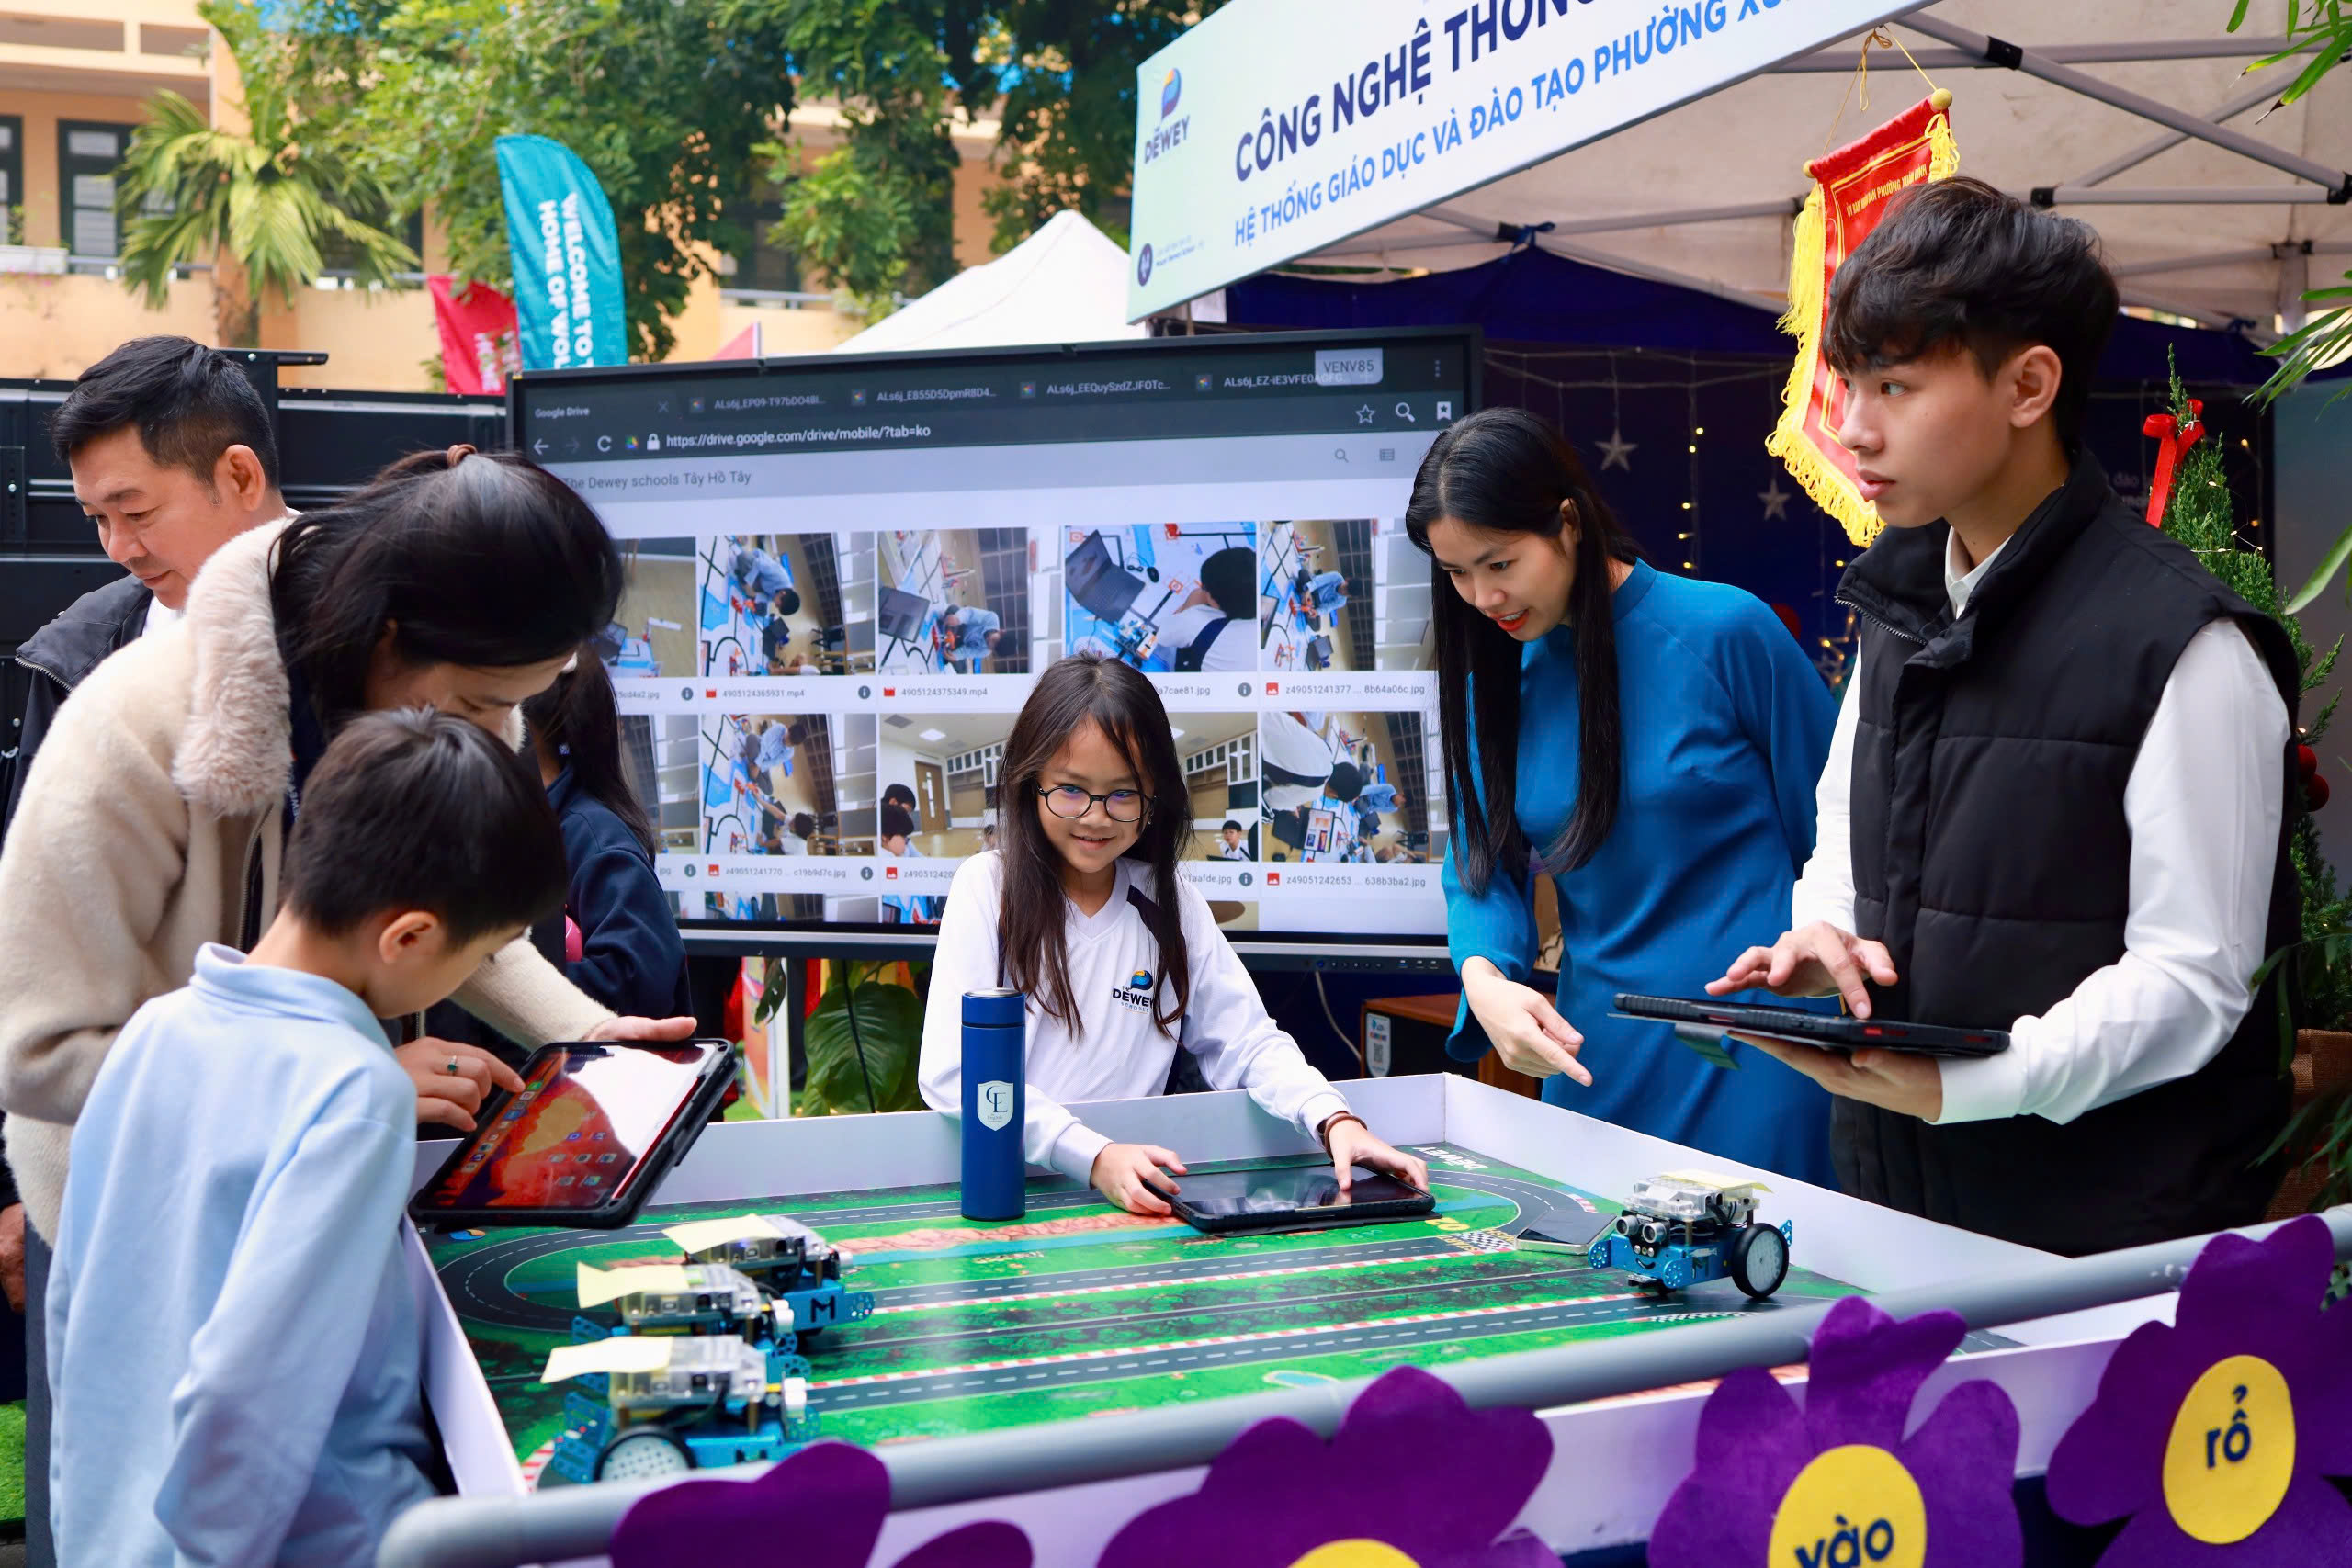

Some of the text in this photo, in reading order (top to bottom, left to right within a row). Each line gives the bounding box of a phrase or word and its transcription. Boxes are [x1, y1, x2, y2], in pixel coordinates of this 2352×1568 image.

[1236, 95, 1321, 182] CÔNG
[1333, 18, 1431, 134] NGHỆ
[1235, 206, 1256, 247] HỆ
[1261, 180, 1322, 233] THỐNG
[1328, 154, 1375, 202] GIÁO
[1382, 132, 1425, 180] DỤC
[1432, 107, 1463, 154] VÀ
[1470, 87, 1523, 140] ĐÀO
[1532, 58, 1585, 111] TẠO
[1594, 0, 1726, 84] PHƯỜNG
[538, 199, 564, 276] HOME
[560, 192, 591, 320] WELCOME
[548, 276, 568, 310] OF
[574, 320, 594, 357] TO
[1323, 359, 1374, 373] VENV85
[535, 406, 590, 419] Google Drive
[666, 424, 931, 448] https://drive.google.com/drive/mobile/?tab=ko
[589, 476, 628, 491] Dewey
[631, 474, 679, 487] schools
[684, 472, 704, 487] Tây
[707, 469, 726, 484] Hồ
[729, 469, 752, 485] Tây
[810, 1295, 835, 1322] M
[2207, 1384, 2252, 1470] rổ
[1794, 1515, 1894, 1568] vào
